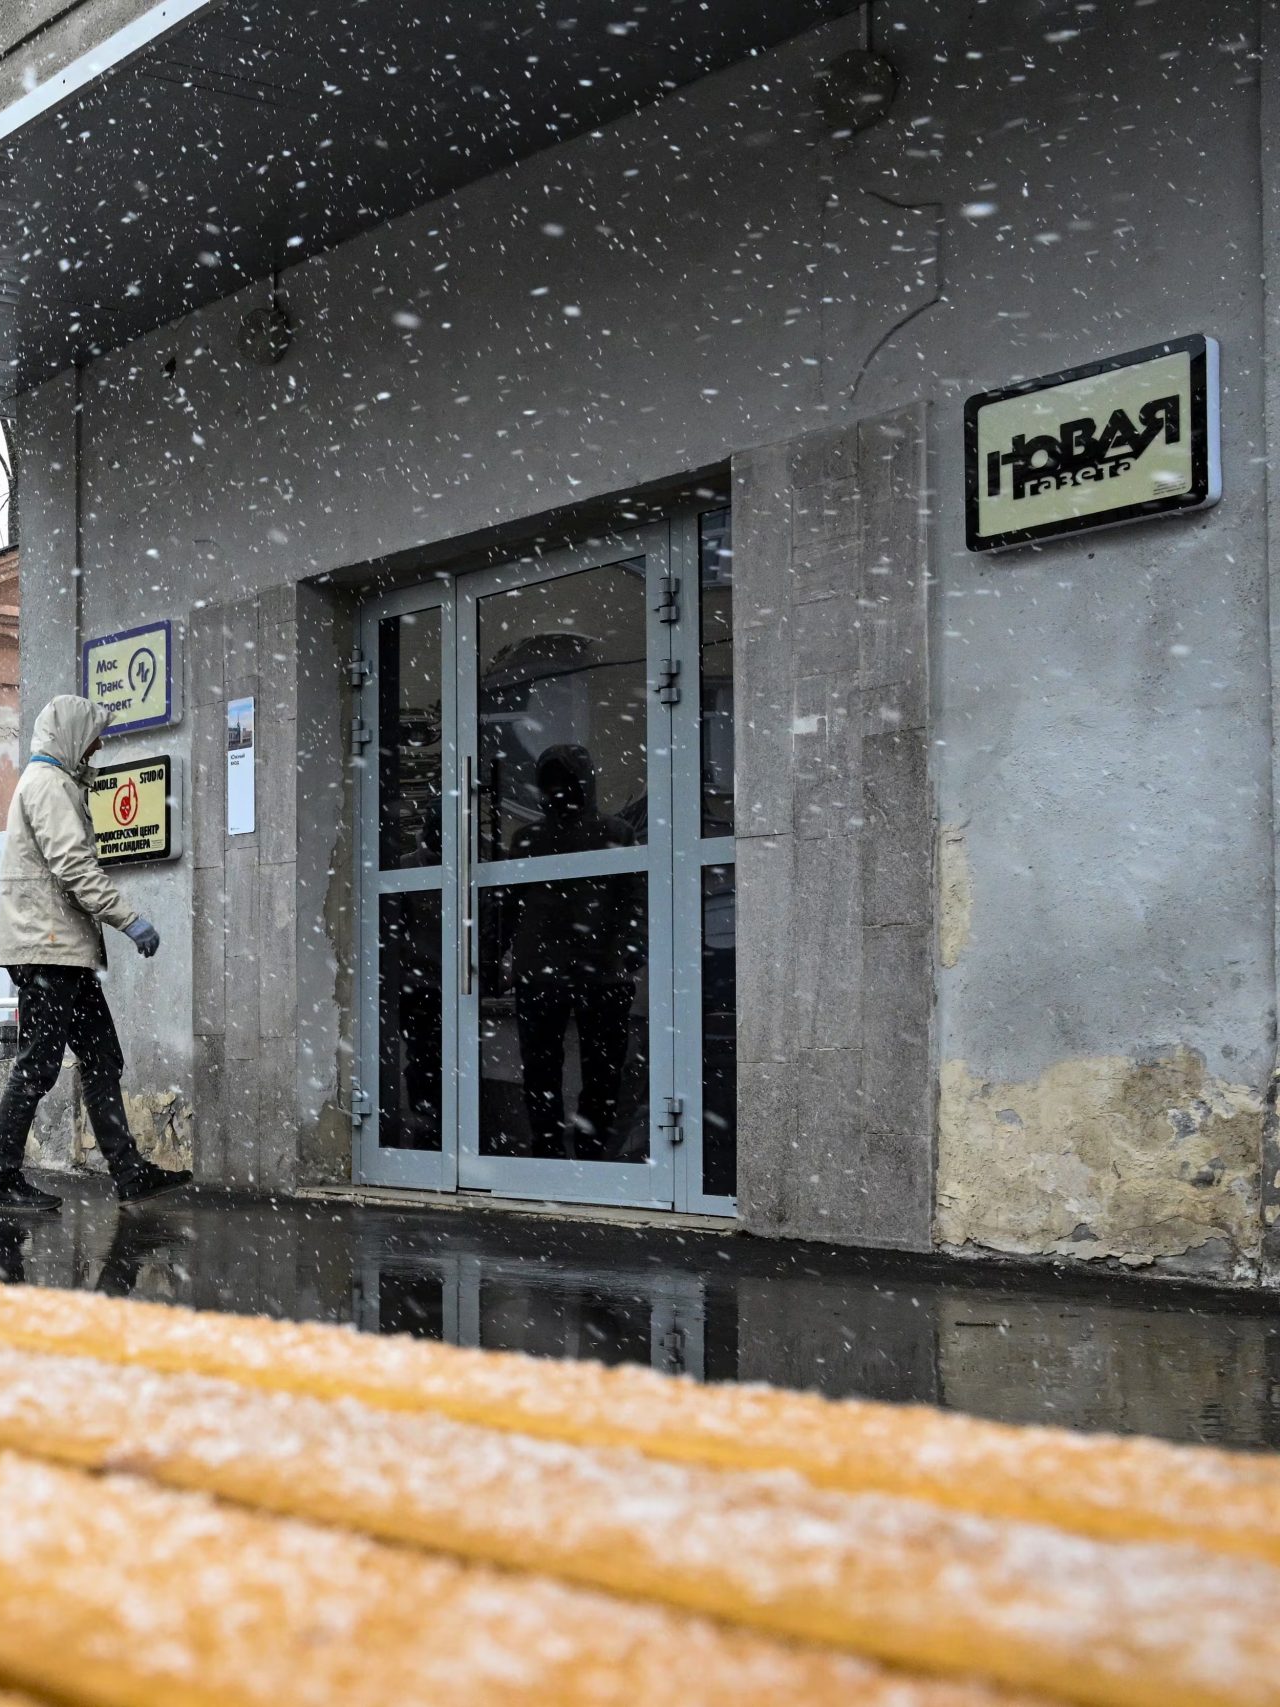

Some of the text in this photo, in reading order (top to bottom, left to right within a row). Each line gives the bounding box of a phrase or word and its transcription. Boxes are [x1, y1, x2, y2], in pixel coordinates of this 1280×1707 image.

[96, 659, 118, 674] Мос
[96, 679, 124, 697] Транс
[97, 698, 132, 713] оект
[90, 768, 164, 792] ANDLER STUDIO
[140, 824, 160, 838] ЦЕНТР
[101, 843, 119, 855] ИГОРЯ
[120, 838, 151, 852] САНДЛЕРА
